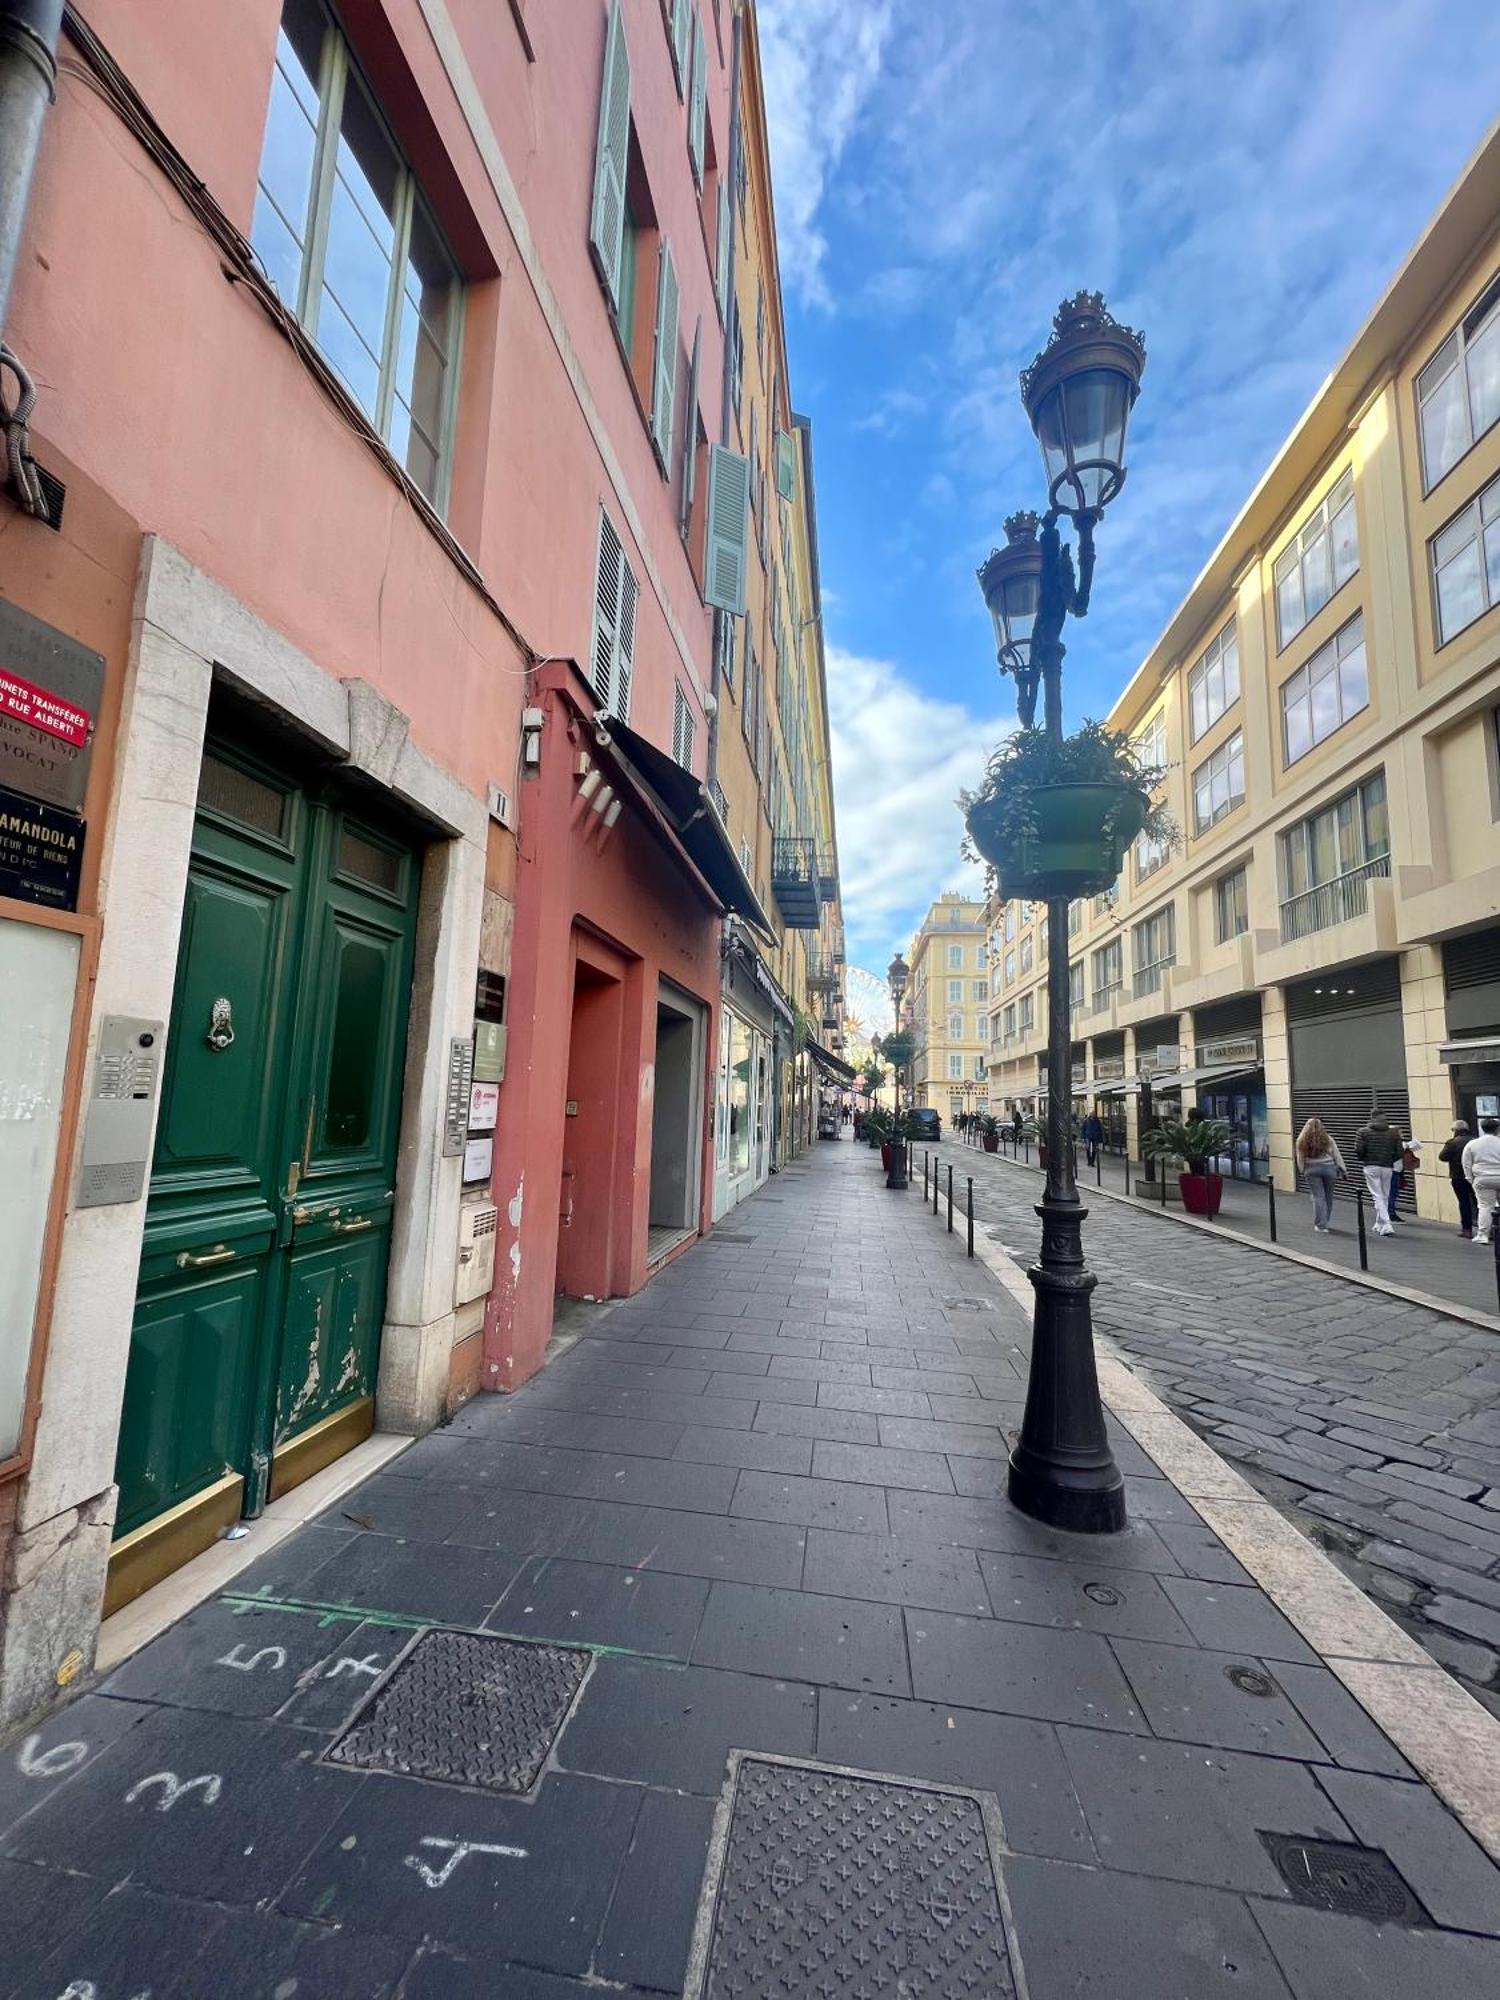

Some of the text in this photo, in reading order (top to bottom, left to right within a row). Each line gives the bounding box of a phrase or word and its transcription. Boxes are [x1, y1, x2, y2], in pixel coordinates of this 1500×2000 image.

[8, 698, 31, 715] RUE
[34, 711, 75, 735] ALBERTI
[32, 694, 85, 727] TRANSFÉRÉS
[0, 813, 76, 851] AMANDOLA
[27, 843, 39, 856] DE
[43, 848, 69, 865] BIENS
